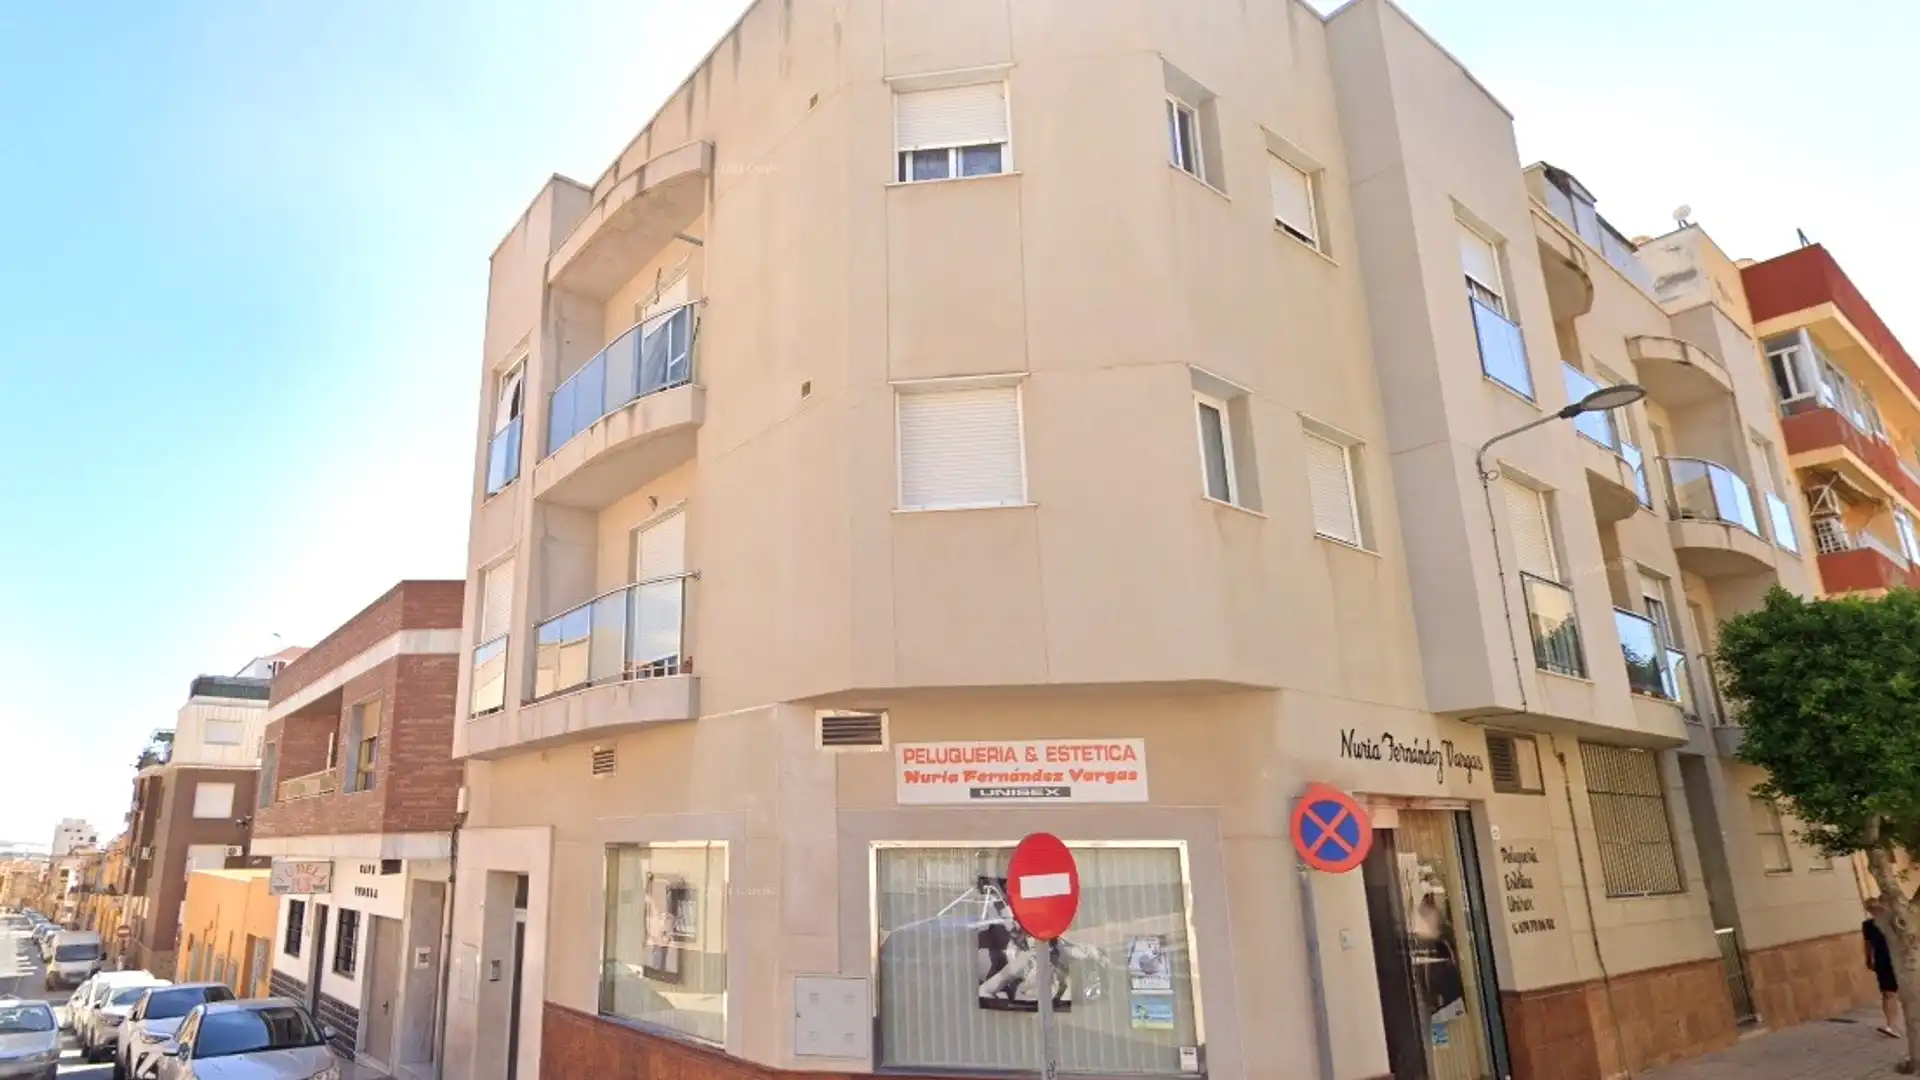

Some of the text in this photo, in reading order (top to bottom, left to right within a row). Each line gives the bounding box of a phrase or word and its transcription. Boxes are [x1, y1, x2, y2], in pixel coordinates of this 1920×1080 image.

[903, 744, 1137, 764] PELUQUERIA & ESTETICA
[1340, 728, 1485, 785] Nuria Fernández Vargas
[963, 768, 1064, 783] Fernández
[1069, 768, 1138, 784] Vargas
[979, 788, 1061, 797] UNISEX
